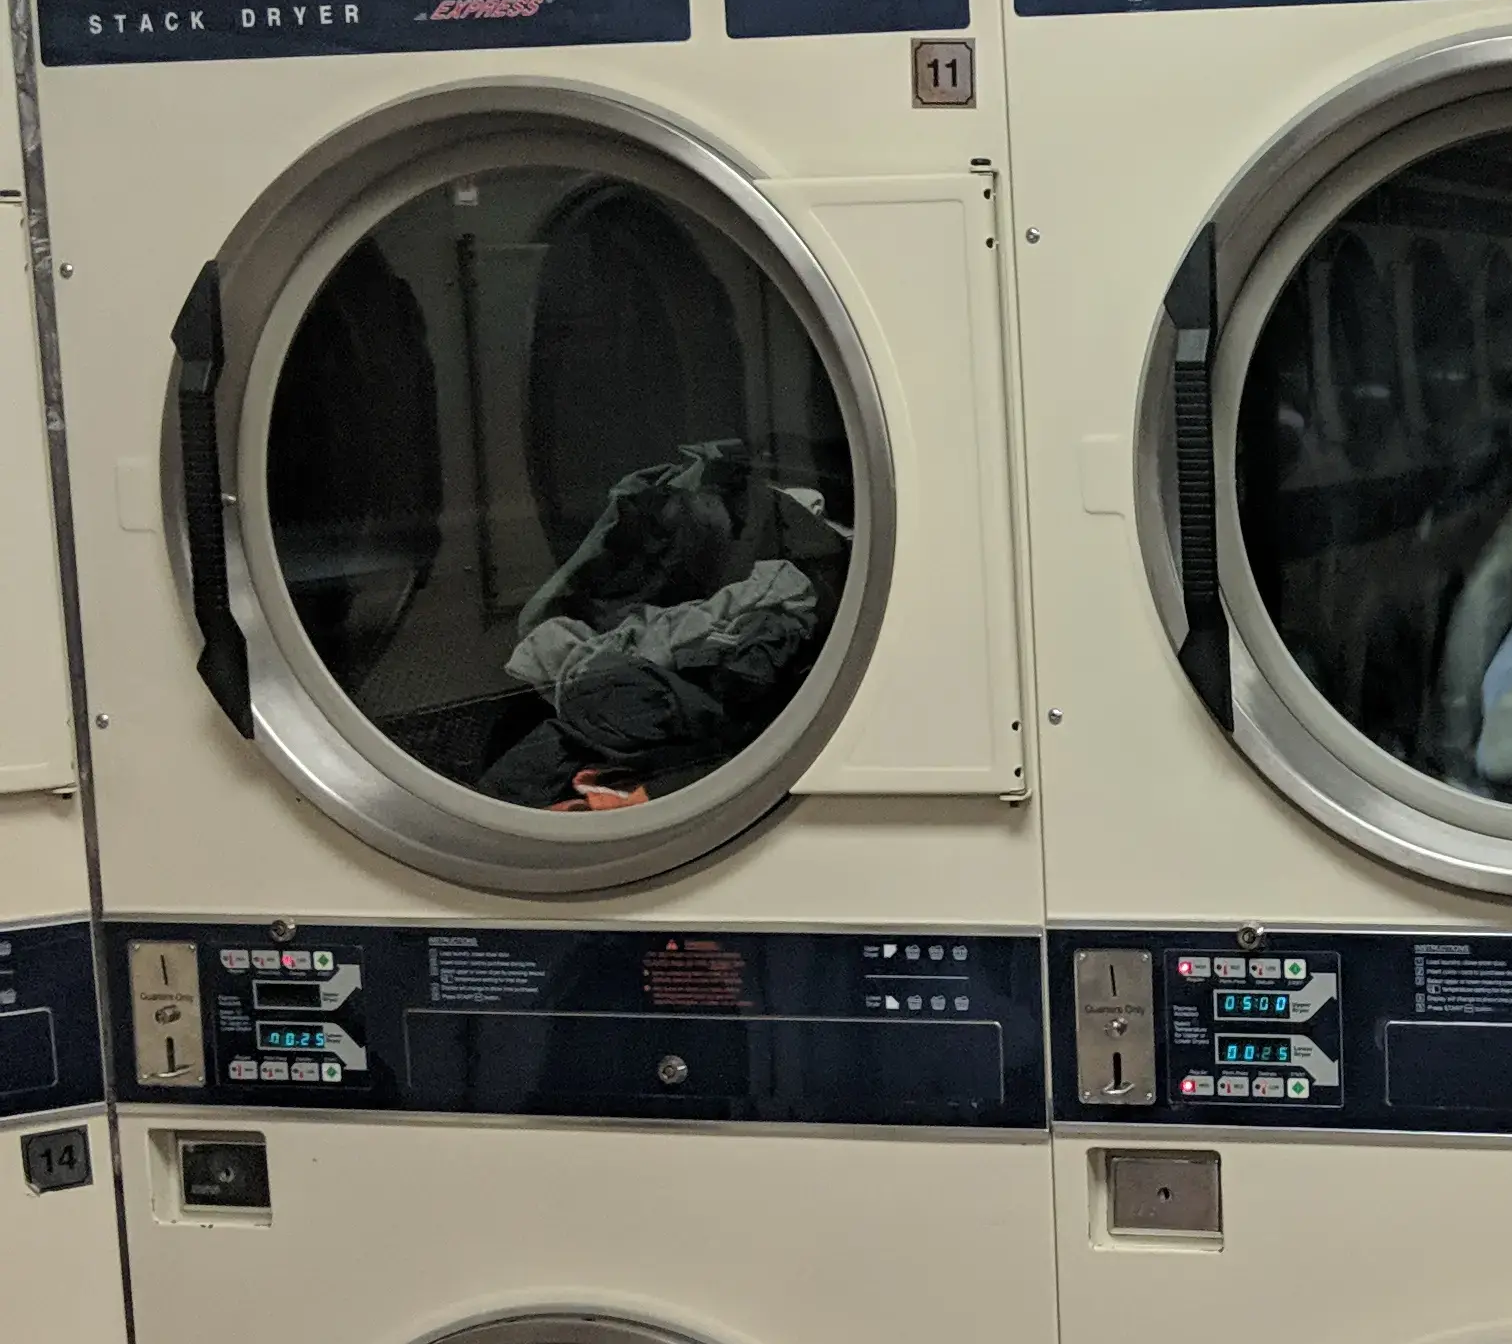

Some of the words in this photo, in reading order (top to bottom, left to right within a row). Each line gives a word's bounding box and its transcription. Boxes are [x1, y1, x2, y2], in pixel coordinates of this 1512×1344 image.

[89, 10, 205, 35] STACK
[241, 4, 360, 28] DRYER
[927, 58, 958, 88] 11
[40, 1144, 77, 1175] 14
